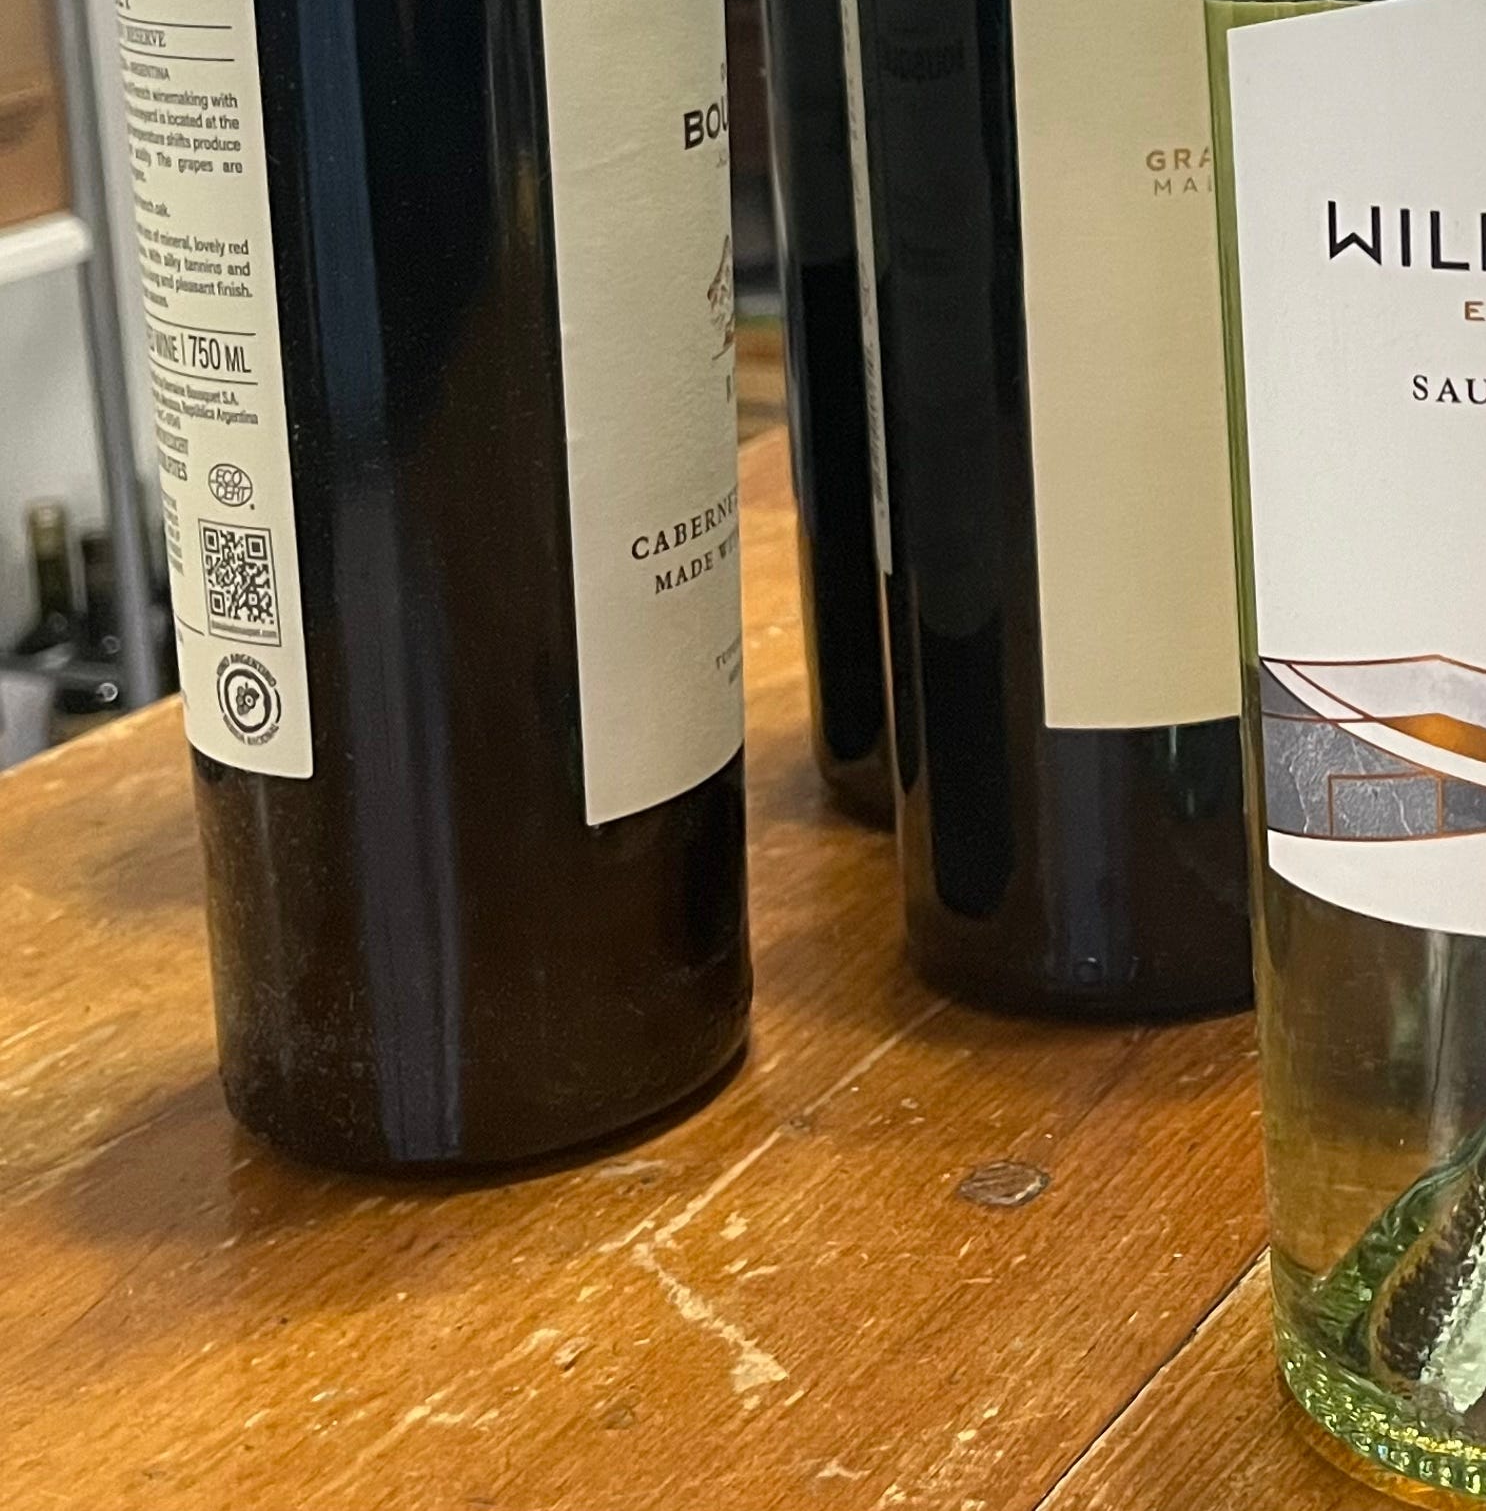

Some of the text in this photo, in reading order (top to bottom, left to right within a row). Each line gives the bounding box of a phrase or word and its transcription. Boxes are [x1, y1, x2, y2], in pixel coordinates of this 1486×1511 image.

[211, 93, 238, 108] with
[167, 110, 203, 128] located
[205, 114, 217, 129] at
[219, 115, 240, 130] the
[193, 136, 241, 153] produce
[178, 158, 213, 174] grapes
[222, 162, 243, 174] are
[193, 235, 225, 257] lovely
[228, 239, 249, 255] red
[184, 257, 222, 275] tannins
[228, 261, 250, 277] and
[217, 281, 253, 298] finish.
[187, 334, 221, 370] 750
[224, 344, 252, 373] ML
[655, 550, 713, 595] MADE
